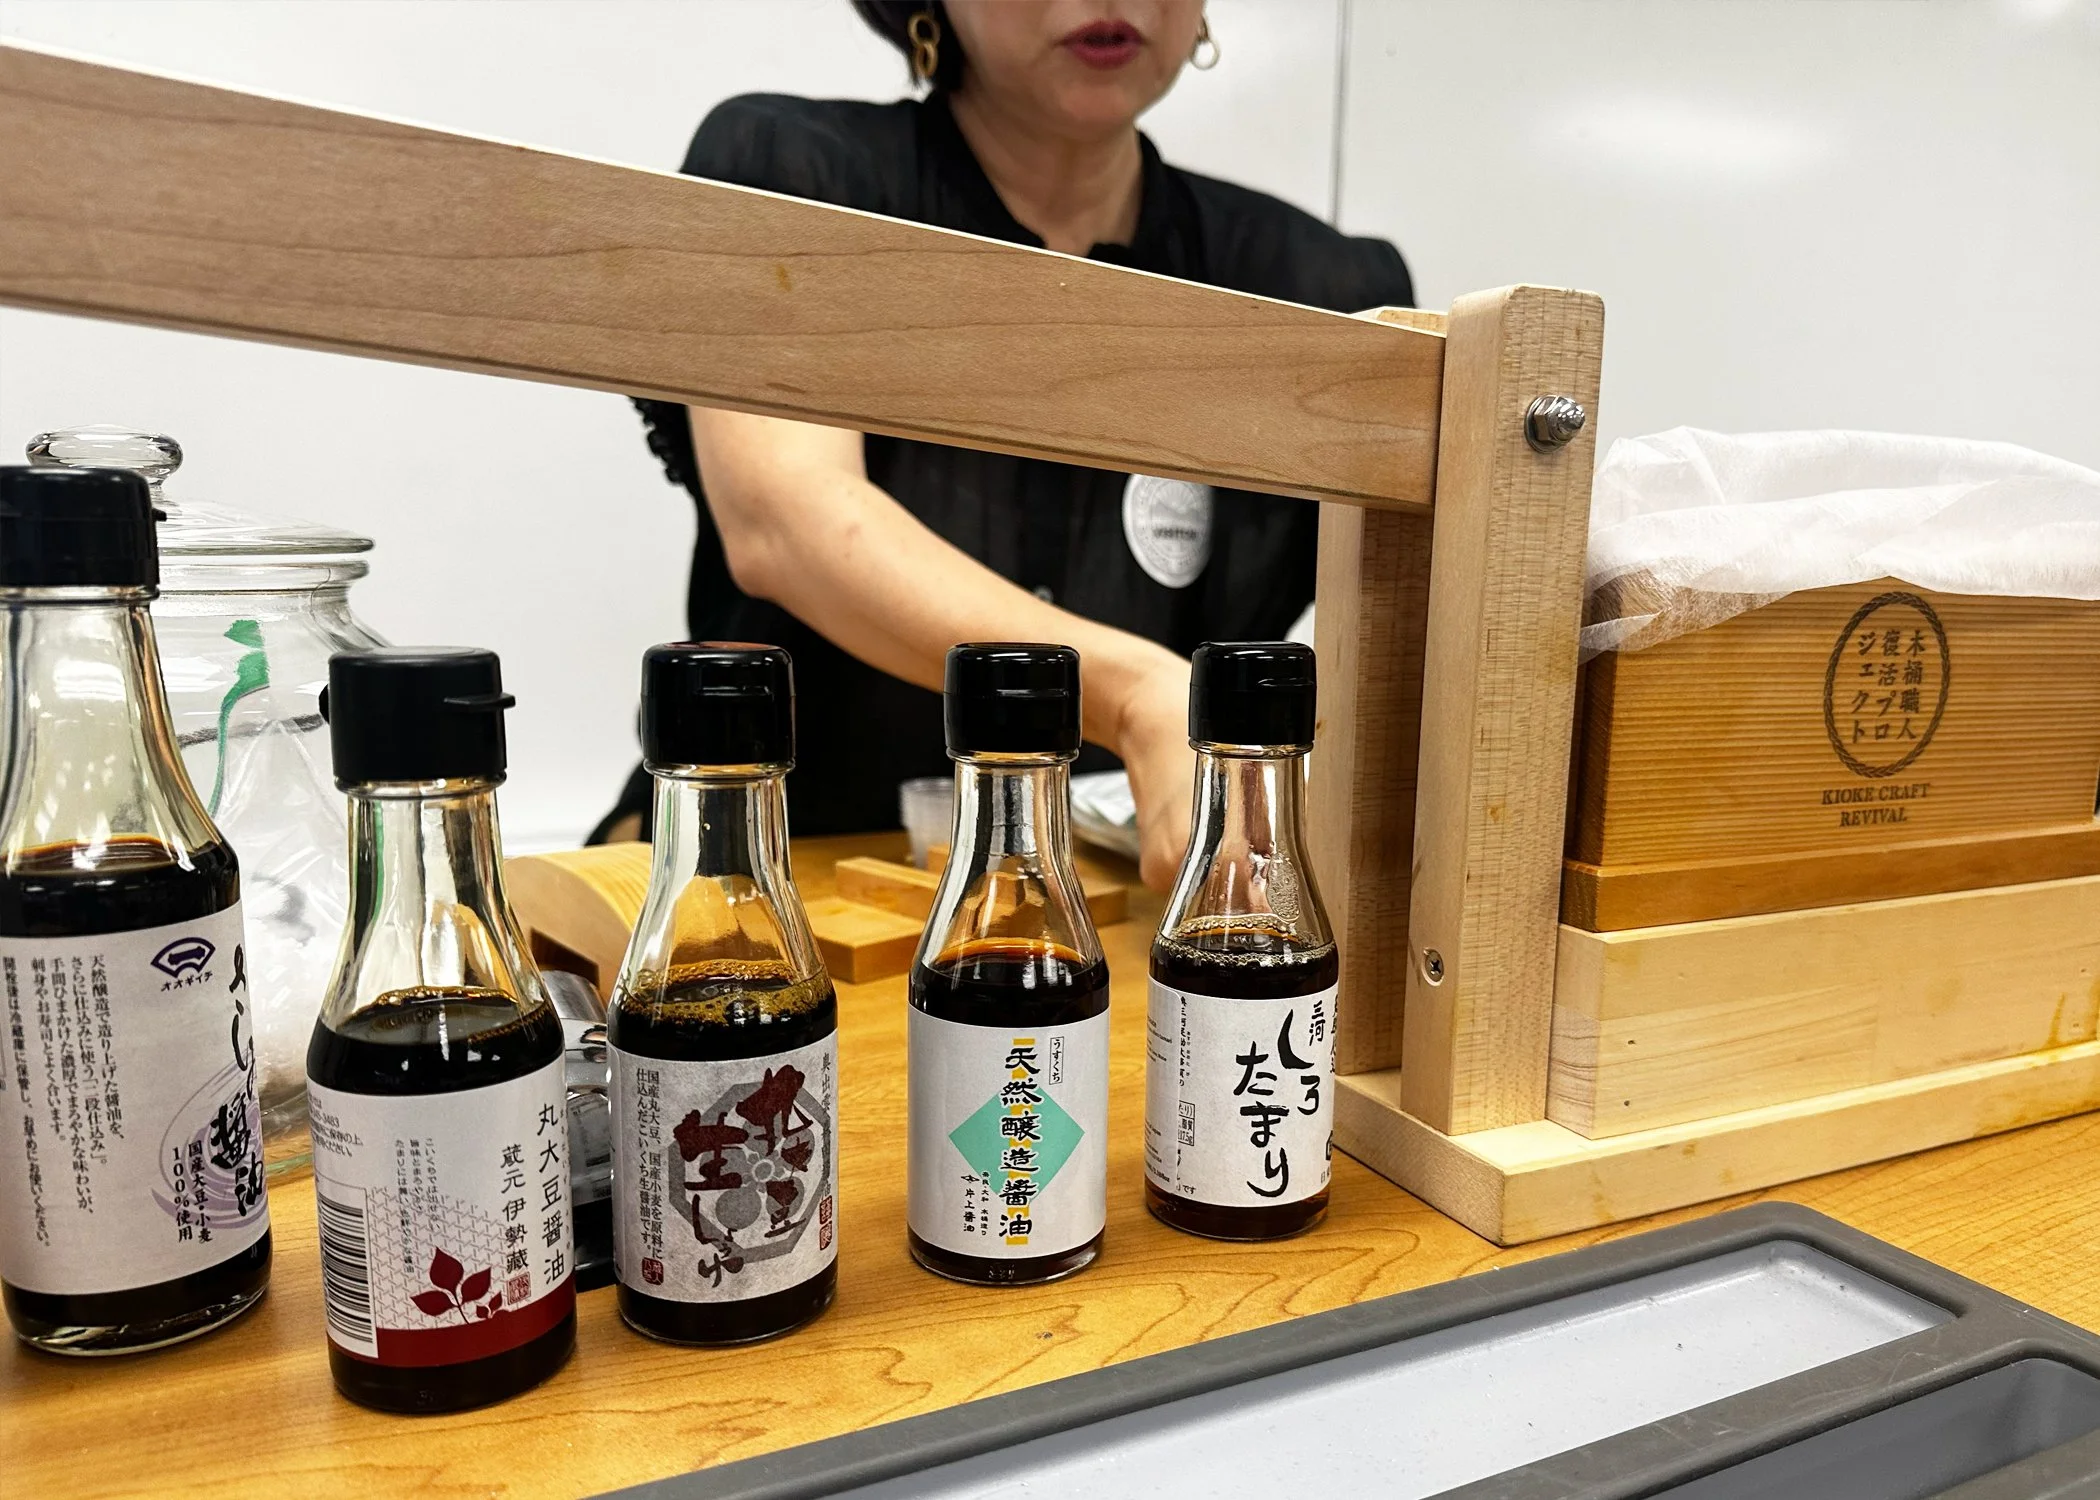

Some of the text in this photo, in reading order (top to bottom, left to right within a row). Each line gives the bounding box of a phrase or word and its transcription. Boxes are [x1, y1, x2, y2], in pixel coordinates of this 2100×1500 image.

[1874, 629, 1901, 741] 復活プロ
[1897, 629, 1926, 741] 木桶職人
[1821, 782, 1931, 806] KIOKE CRAFT
[1839, 806, 1908, 828] REVIVAL
[160, 970, 213, 992] オオギイチ
[1309, 1000, 1326, 1047] 三河
[1051, 1037, 1062, 1083] うすくち
[1276, 1009, 1320, 1116] しろ
[1233, 1041, 1290, 1198] たまり
[172, 1147, 194, 1243] 100%使用
[188, 1141, 213, 1243] 国産大豆・小麦
[537, 1103, 565, 1285] 丸大豆醤油
